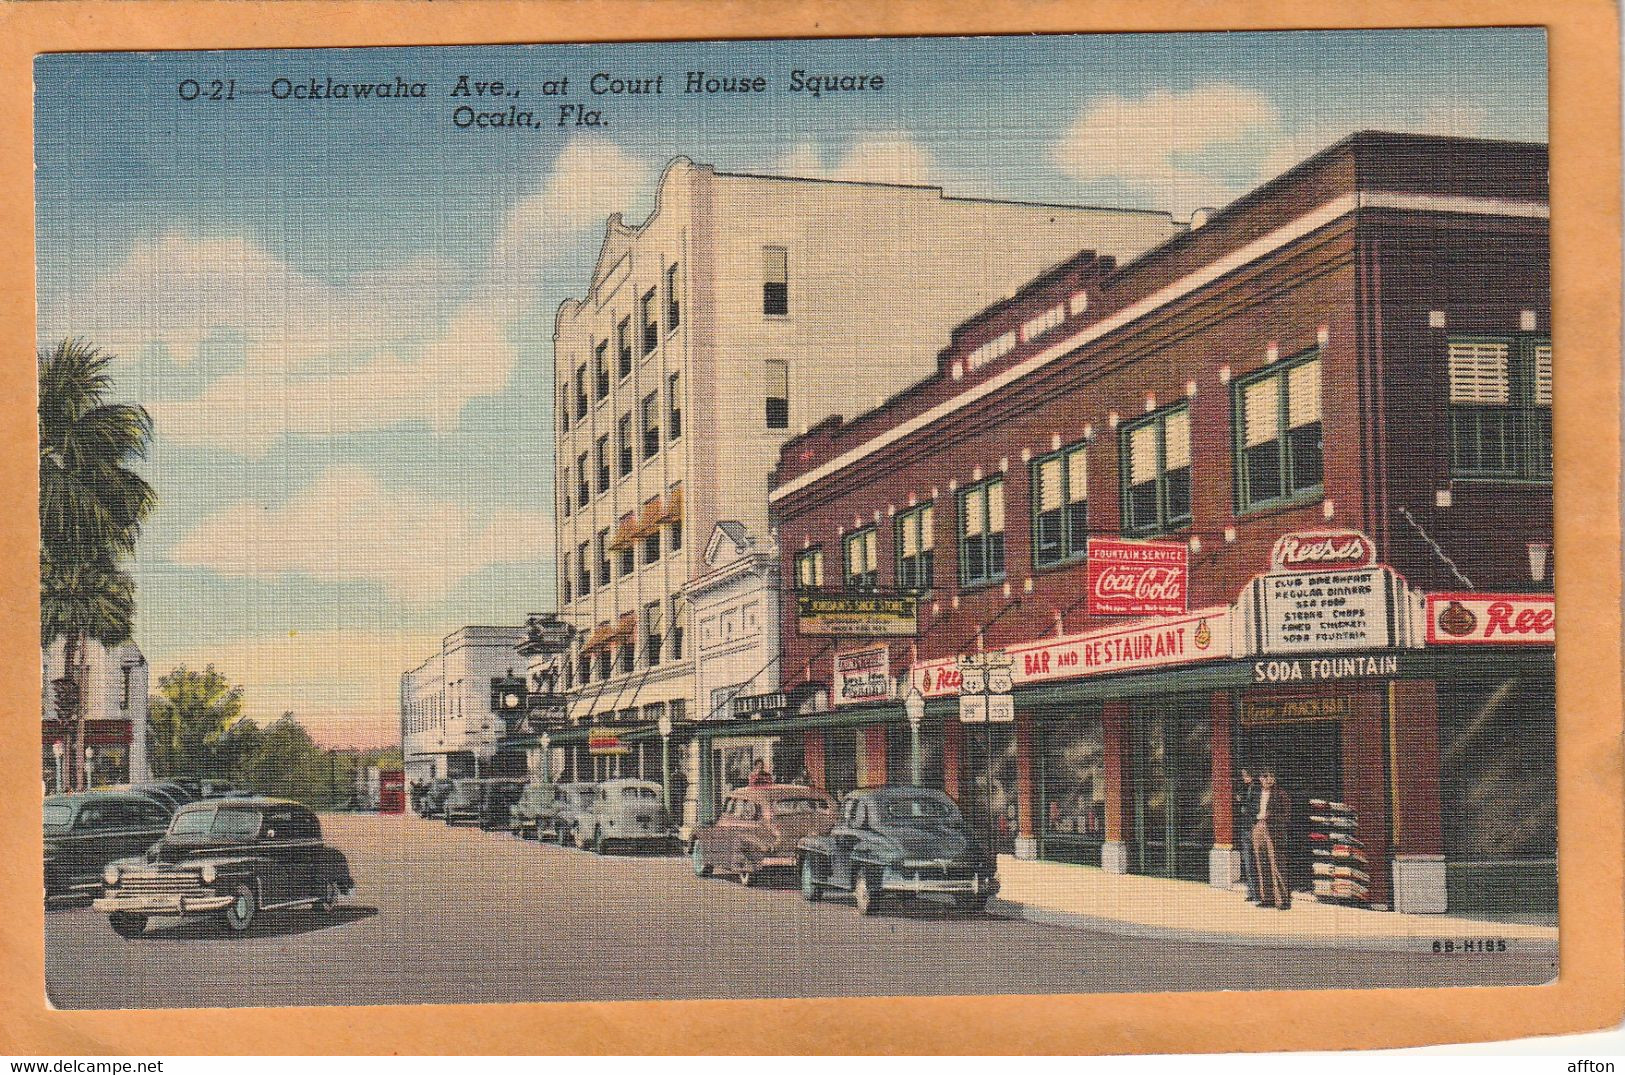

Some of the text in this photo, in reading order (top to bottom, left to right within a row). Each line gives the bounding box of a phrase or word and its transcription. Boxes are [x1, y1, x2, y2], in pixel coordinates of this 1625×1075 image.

[1094, 549, 1183, 561] FOUNTAIN SERVICE
[1024, 651, 1050, 676] BAR
[1057, 652, 1078, 668] AND
[1085, 628, 1185, 667] RESTAURANT
[1254, 656, 1397, 682] SODA FOUNTAIN
